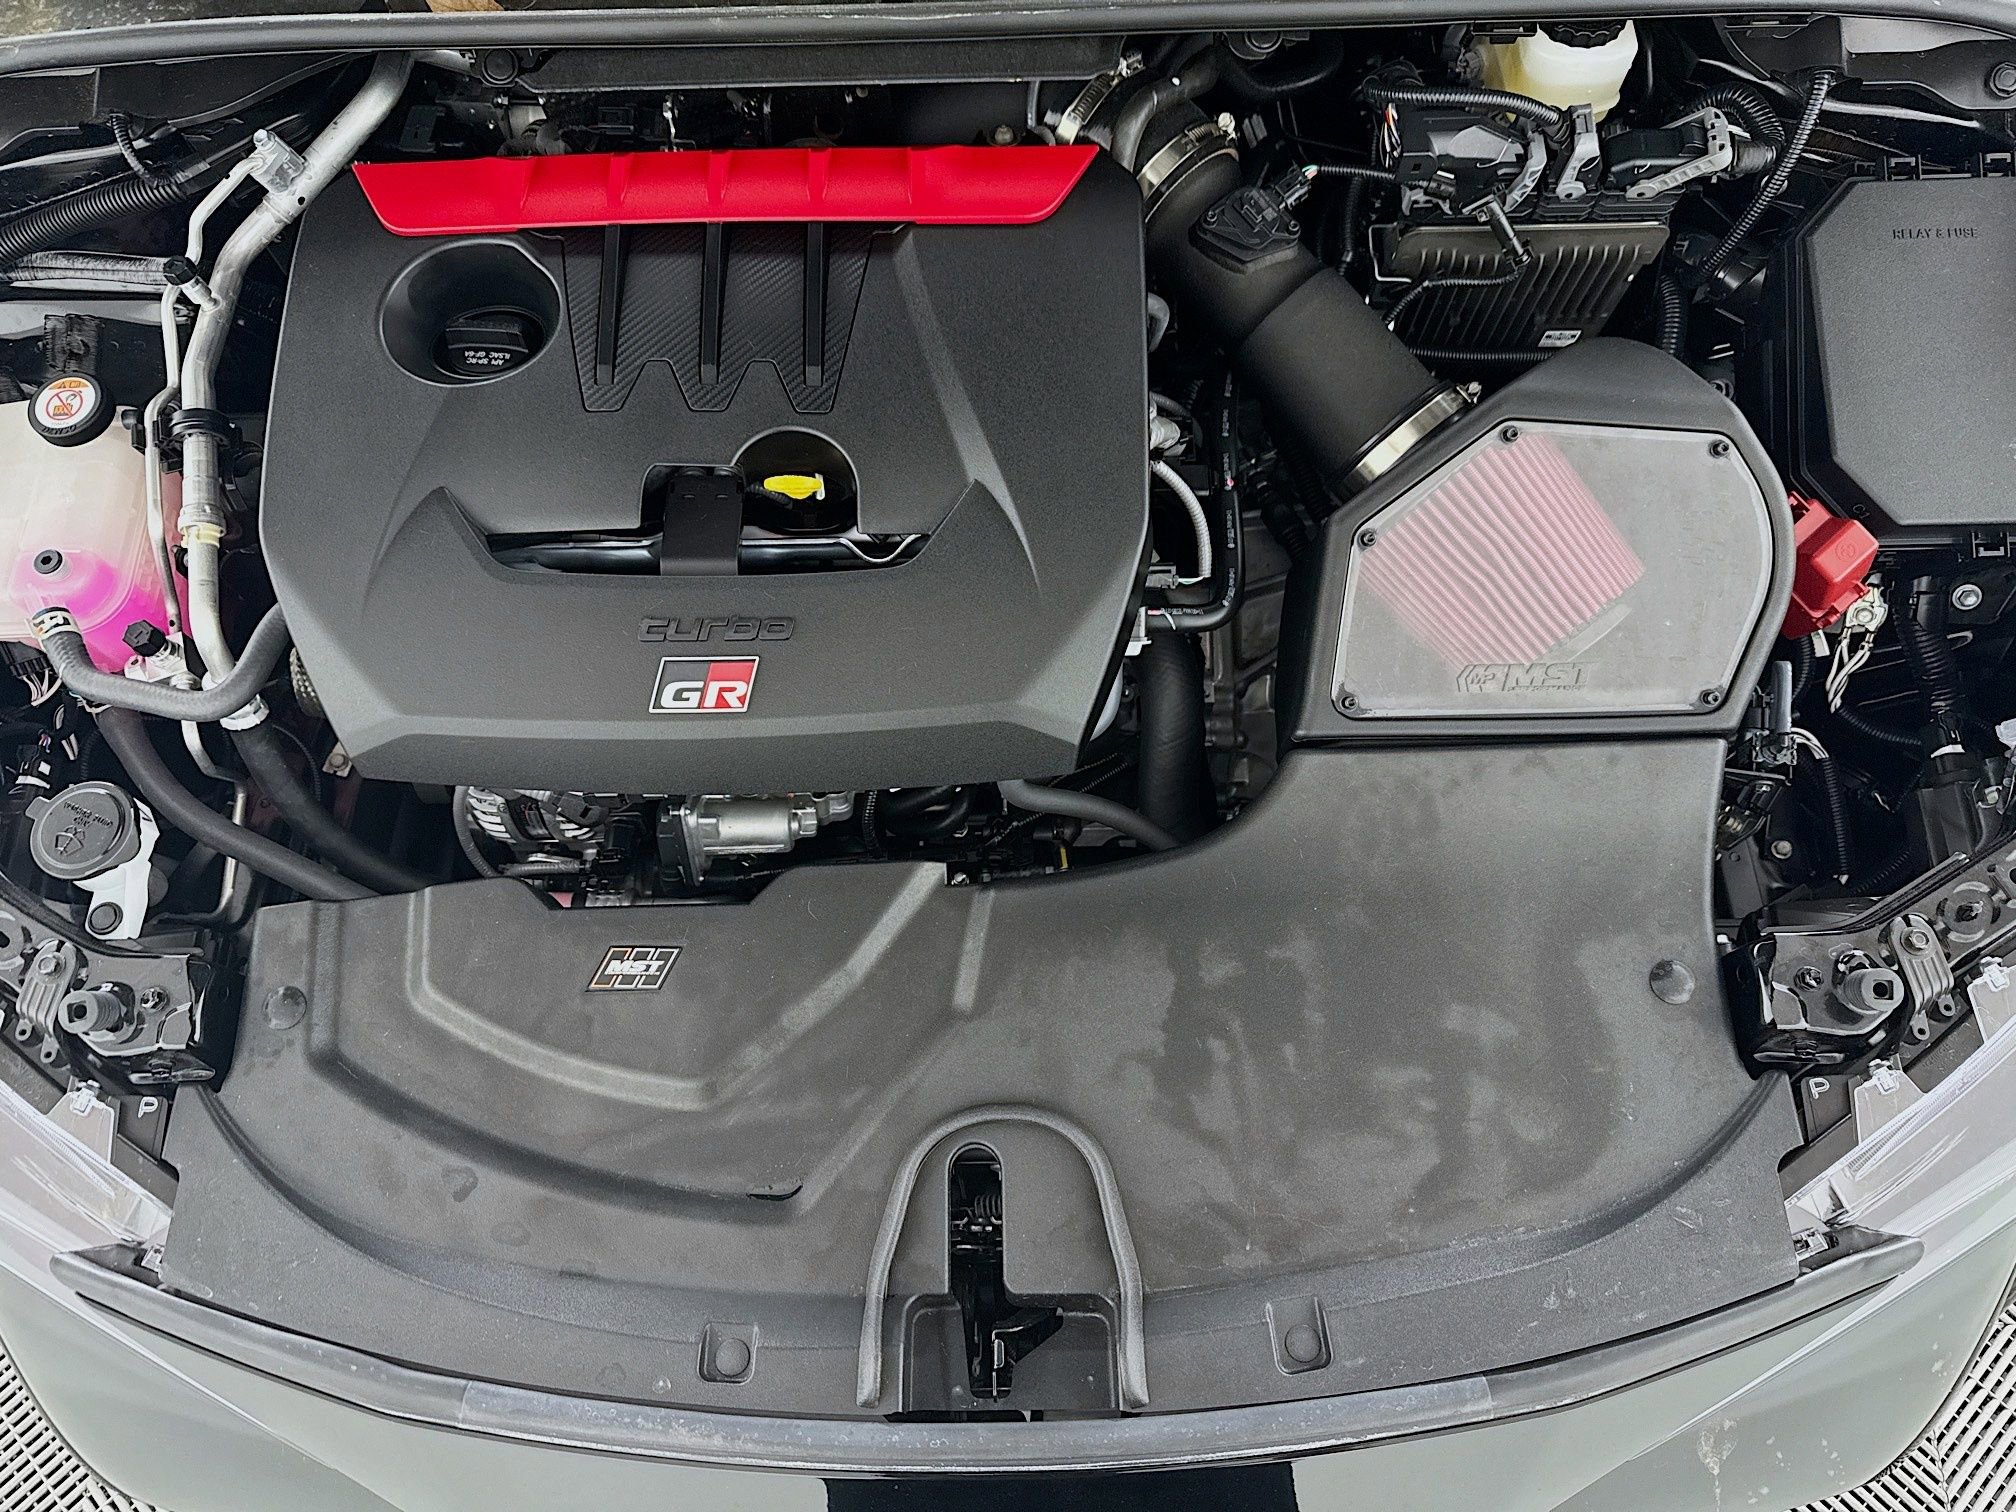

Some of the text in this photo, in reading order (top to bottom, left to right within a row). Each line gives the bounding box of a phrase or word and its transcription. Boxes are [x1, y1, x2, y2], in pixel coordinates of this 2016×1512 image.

[1892, 228, 1932, 240] RELAY
[488, 352, 511, 360] ILSAC
[41, 424, 77, 436] DENSO
[637, 615, 795, 642] turbo
[1508, 663, 1598, 686] MST
[660, 680, 749, 709] GR
[605, 959, 665, 973] MST
[1809, 1077, 1830, 1100] P
[137, 1096, 159, 1119] P
